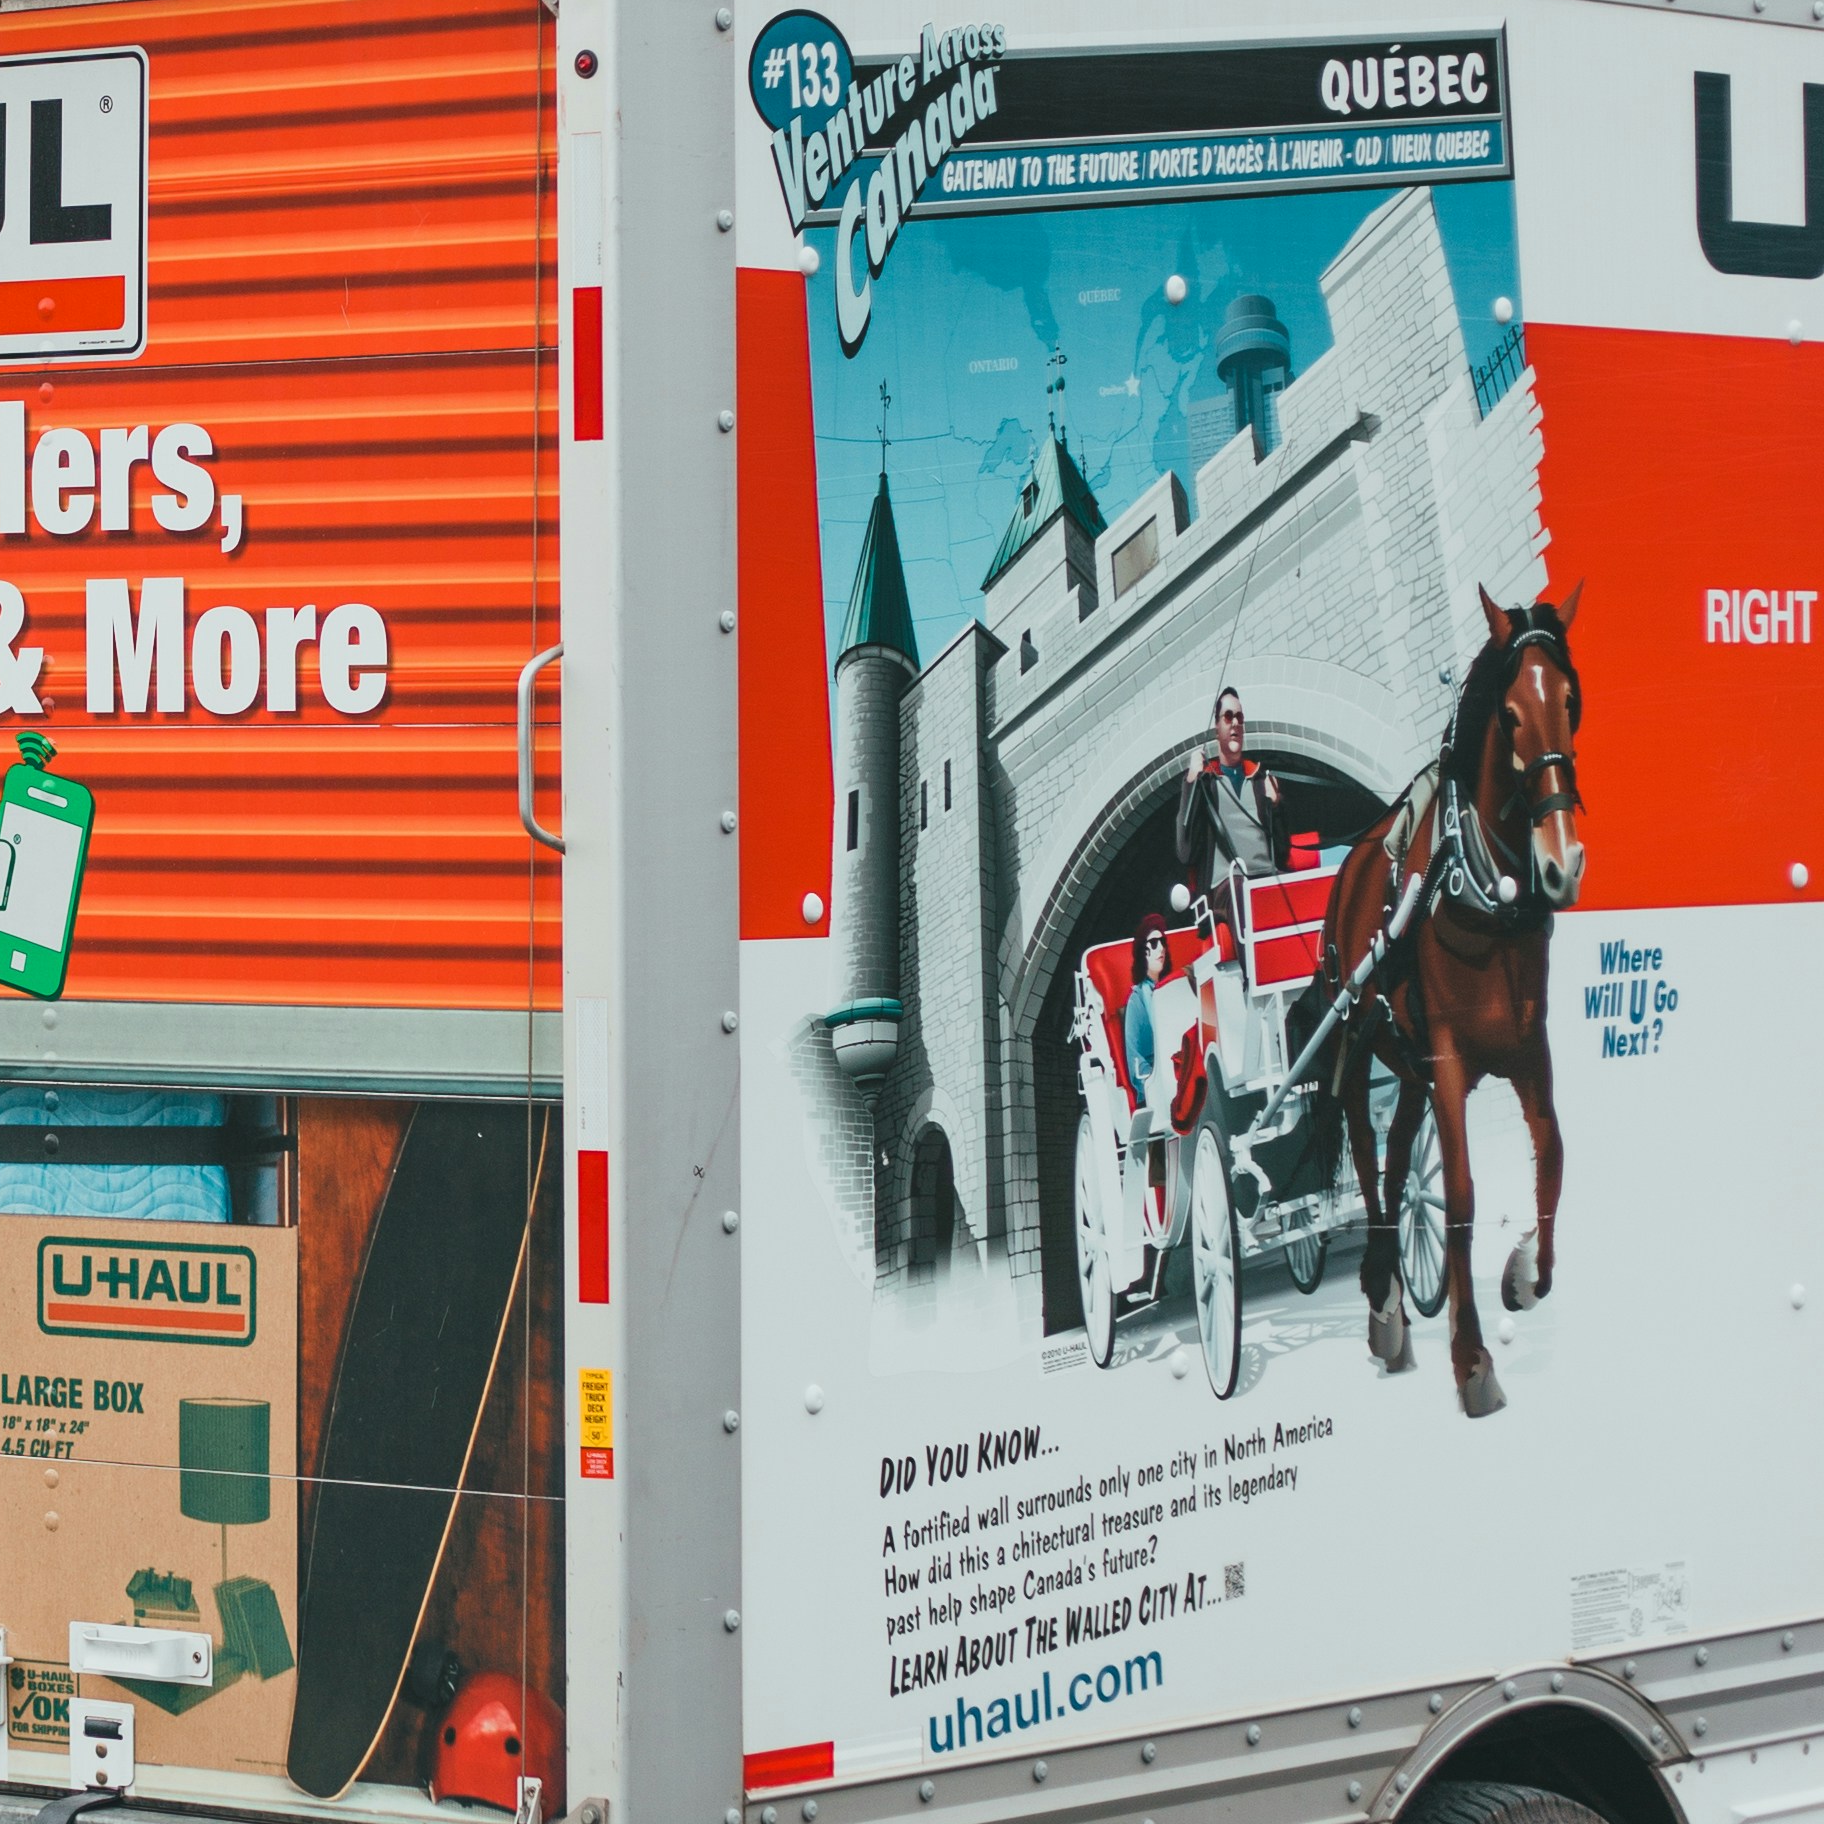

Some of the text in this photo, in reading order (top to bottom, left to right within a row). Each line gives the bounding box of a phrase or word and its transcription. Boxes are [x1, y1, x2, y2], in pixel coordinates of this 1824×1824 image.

[762, 41, 840, 109] #133
[1321, 44, 1488, 115] QUÉBEC
[771, 22, 1007, 231] Venture Across
[943, 156, 1016, 193] GATEWAY
[1021, 156, 1042, 187] TO
[1046, 153, 1076, 185] THE
[1079, 150, 1138, 184] FUTURE
[1149, 147, 1198, 179] PORTE
[1201, 138, 1264, 177] D'ACCÈS
[1281, 138, 1344, 172] L'AVENIR
[1355, 135, 1382, 167] OLD
[1391, 133, 1432, 165] VIEUX
[835, 62, 999, 346] Canada
[1078, 286, 1122, 306] QUÉBEC
[969, 357, 1019, 374] ONTARIO
[1706, 588, 1818, 644] RIGHT
[86, 576, 388, 716] More
[1599, 939, 1663, 975] Where
[1584, 979, 1678, 1025] Will U Go
[1602, 1018, 1663, 1058] Next?
[52, 1253, 242, 1307] U-HAUL
[1, 1373, 144, 1414] LARGE BOX
[582, 1382, 608, 1391] FREIGHT
[585, 1393, 606, 1402] TRUCK
[587, 1404, 604, 1413] DECK
[1, 1437, 74, 1459] 4.5 CU FT
[2, 1415, 90, 1435] 18" x 18" x 24"
[880, 1424, 1060, 1499] DID YOU KNOW...
[882, 1415, 1333, 1558] A fortified wall surrounds only one city in North America
[884, 1565, 921, 1597] How
[927, 1551, 952, 1584] did
[959, 1545, 990, 1577] this
[1101, 1503, 1164, 1537] treasure
[1170, 1484, 1197, 1518] and
[1203, 1483, 1222, 1508] its
[1228, 1463, 1298, 1505] legendary
[886, 1535, 1158, 1645] past help shape Canada's future?
[890, 1572, 1222, 1698] LEARN ABOUT THE WALLED CITY AT...
[27, 1669, 74, 1683] U-HAUL
[27, 1681, 74, 1694] BOXES
[33, 1696, 70, 1722] OK
[929, 1650, 1164, 1754] uhaul.com
[12, 1721, 70, 1737] FOR SHIPPIN
